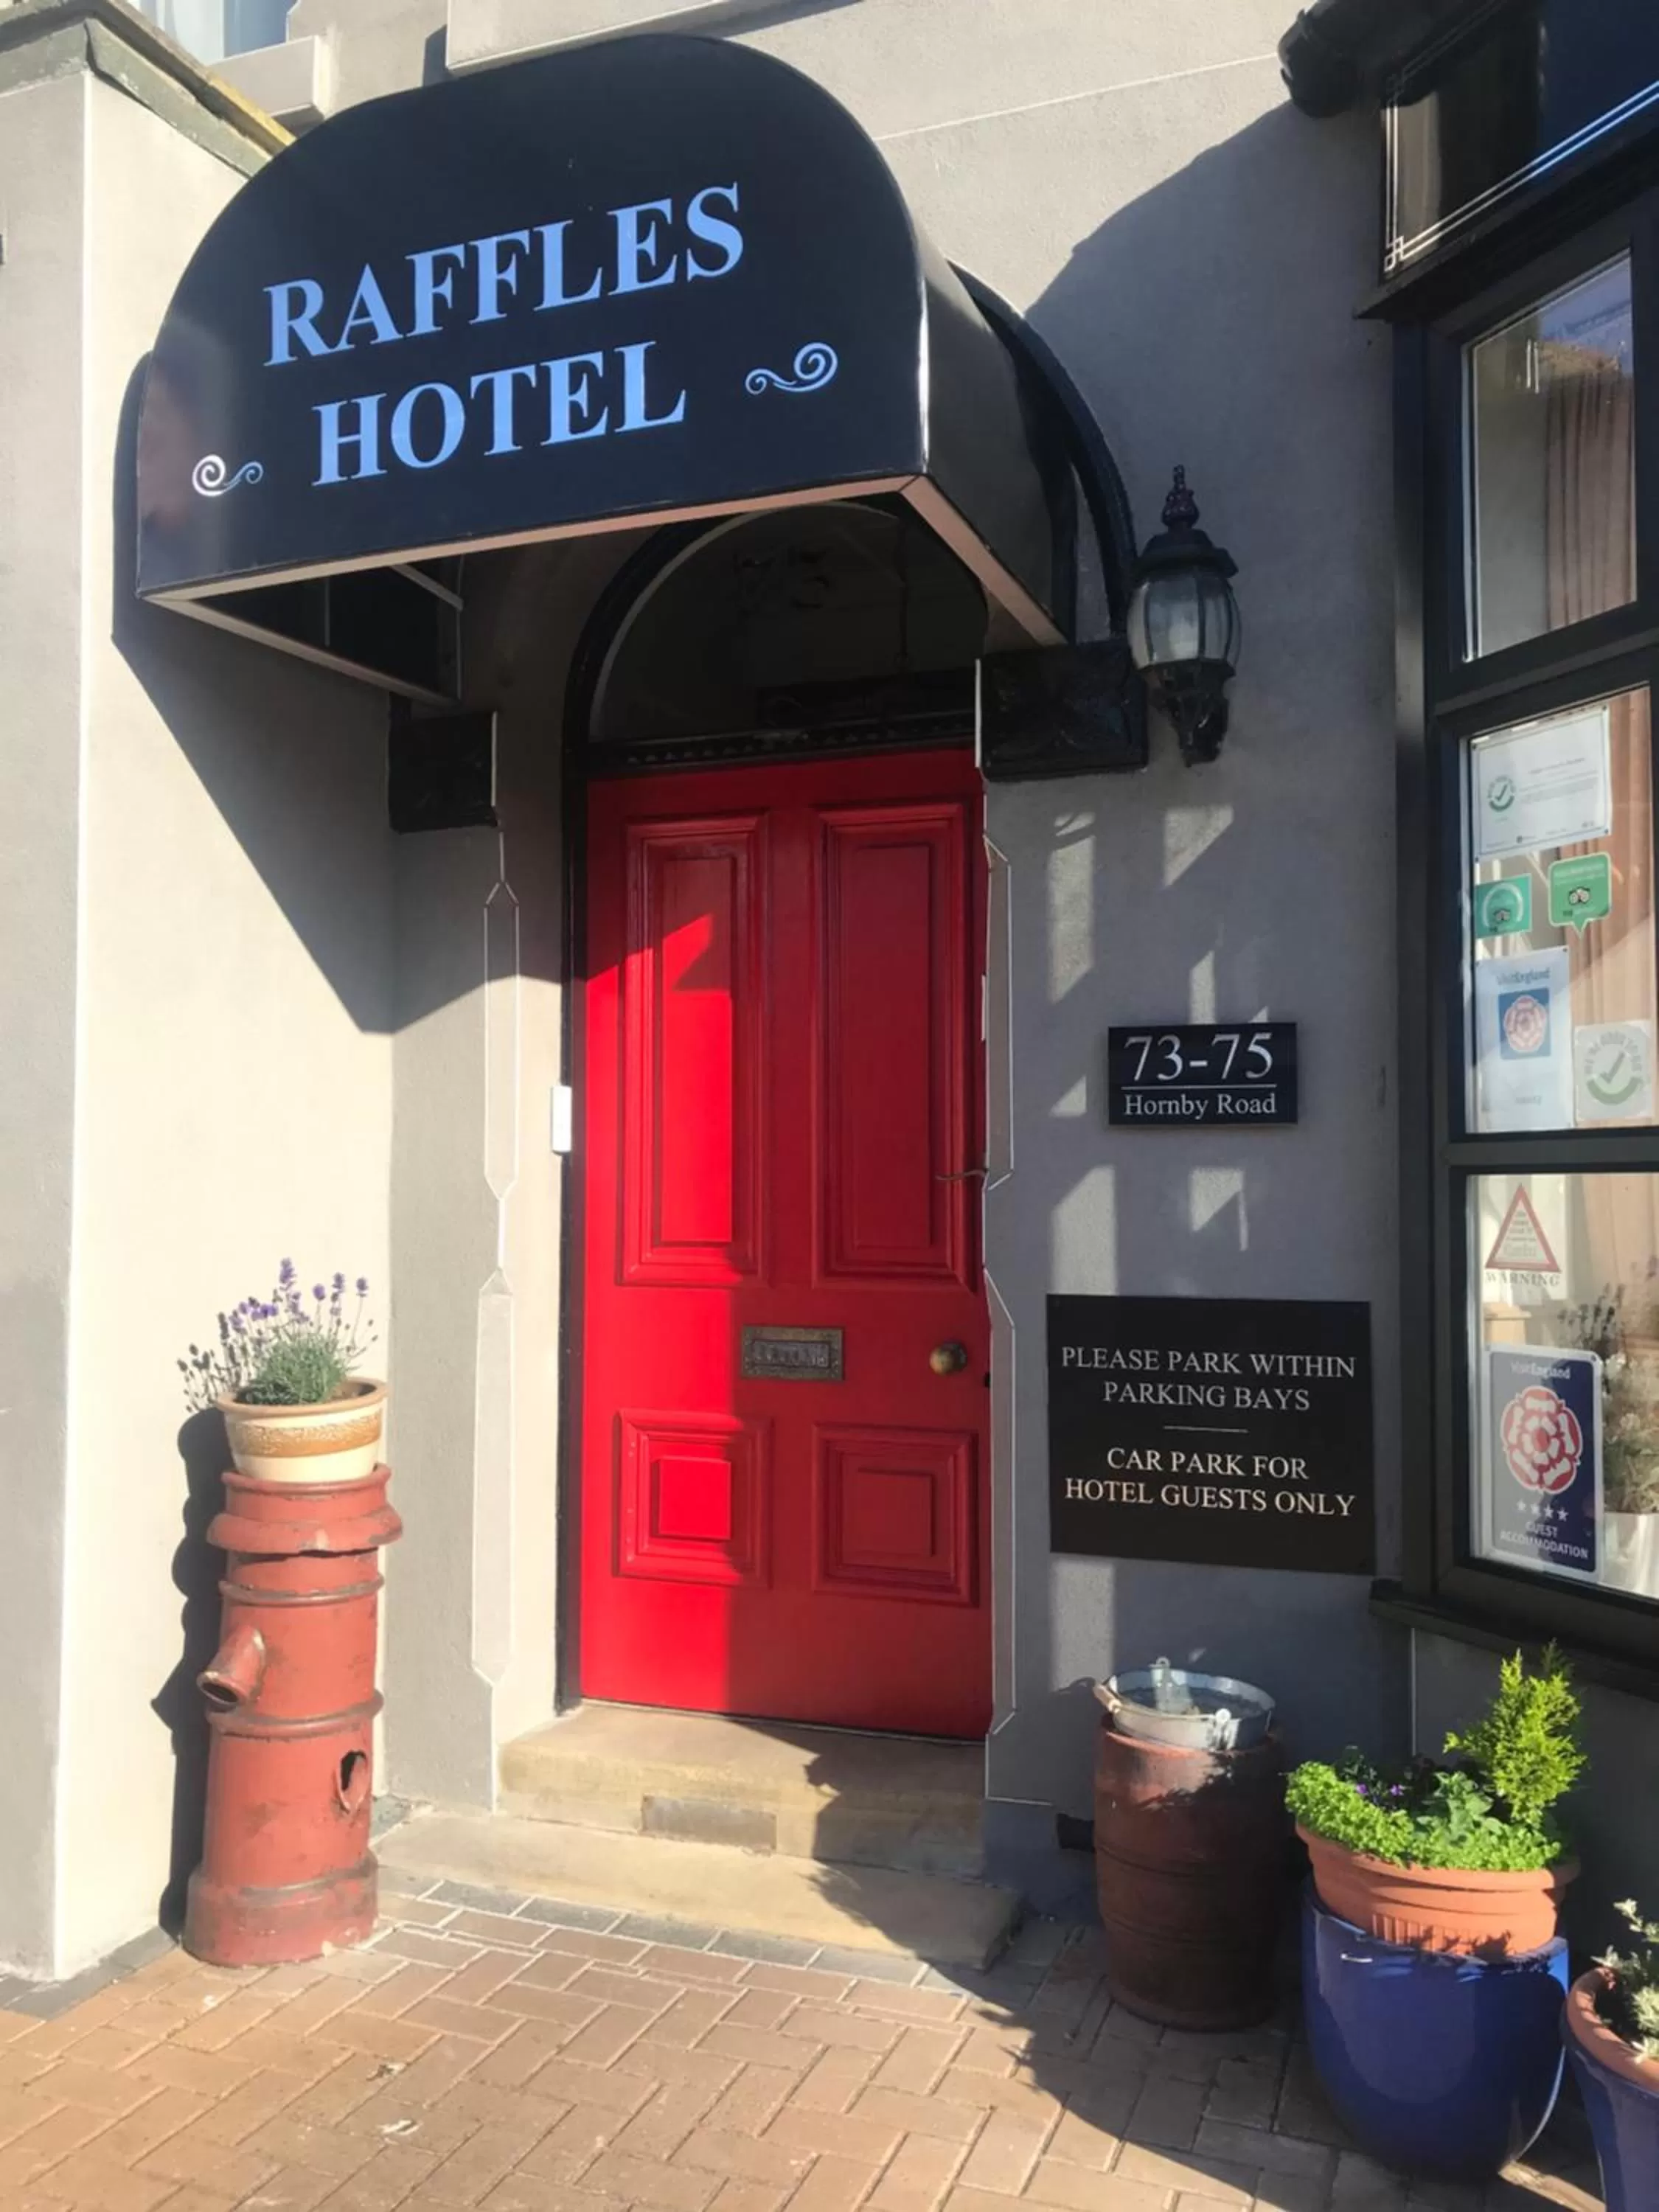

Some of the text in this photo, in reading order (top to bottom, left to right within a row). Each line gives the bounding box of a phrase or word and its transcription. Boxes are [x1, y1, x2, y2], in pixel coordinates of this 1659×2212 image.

[263, 181, 744, 366] RAFFLES
[311, 341, 686, 486] HOTEL
[1124, 1032, 1273, 1080] 73-75
[1124, 1092, 1276, 1119] Hornby Road
[1485, 1271, 1560, 1287] WARNING
[1062, 1347, 1356, 1377] PLEASE PARK WITHIN
[1103, 1382, 1310, 1411] PARKING BAYS
[1107, 1447, 1310, 1479] CAR PARK FOR
[1065, 1478, 1355, 1517] HOTEL GUESTS ONLY
